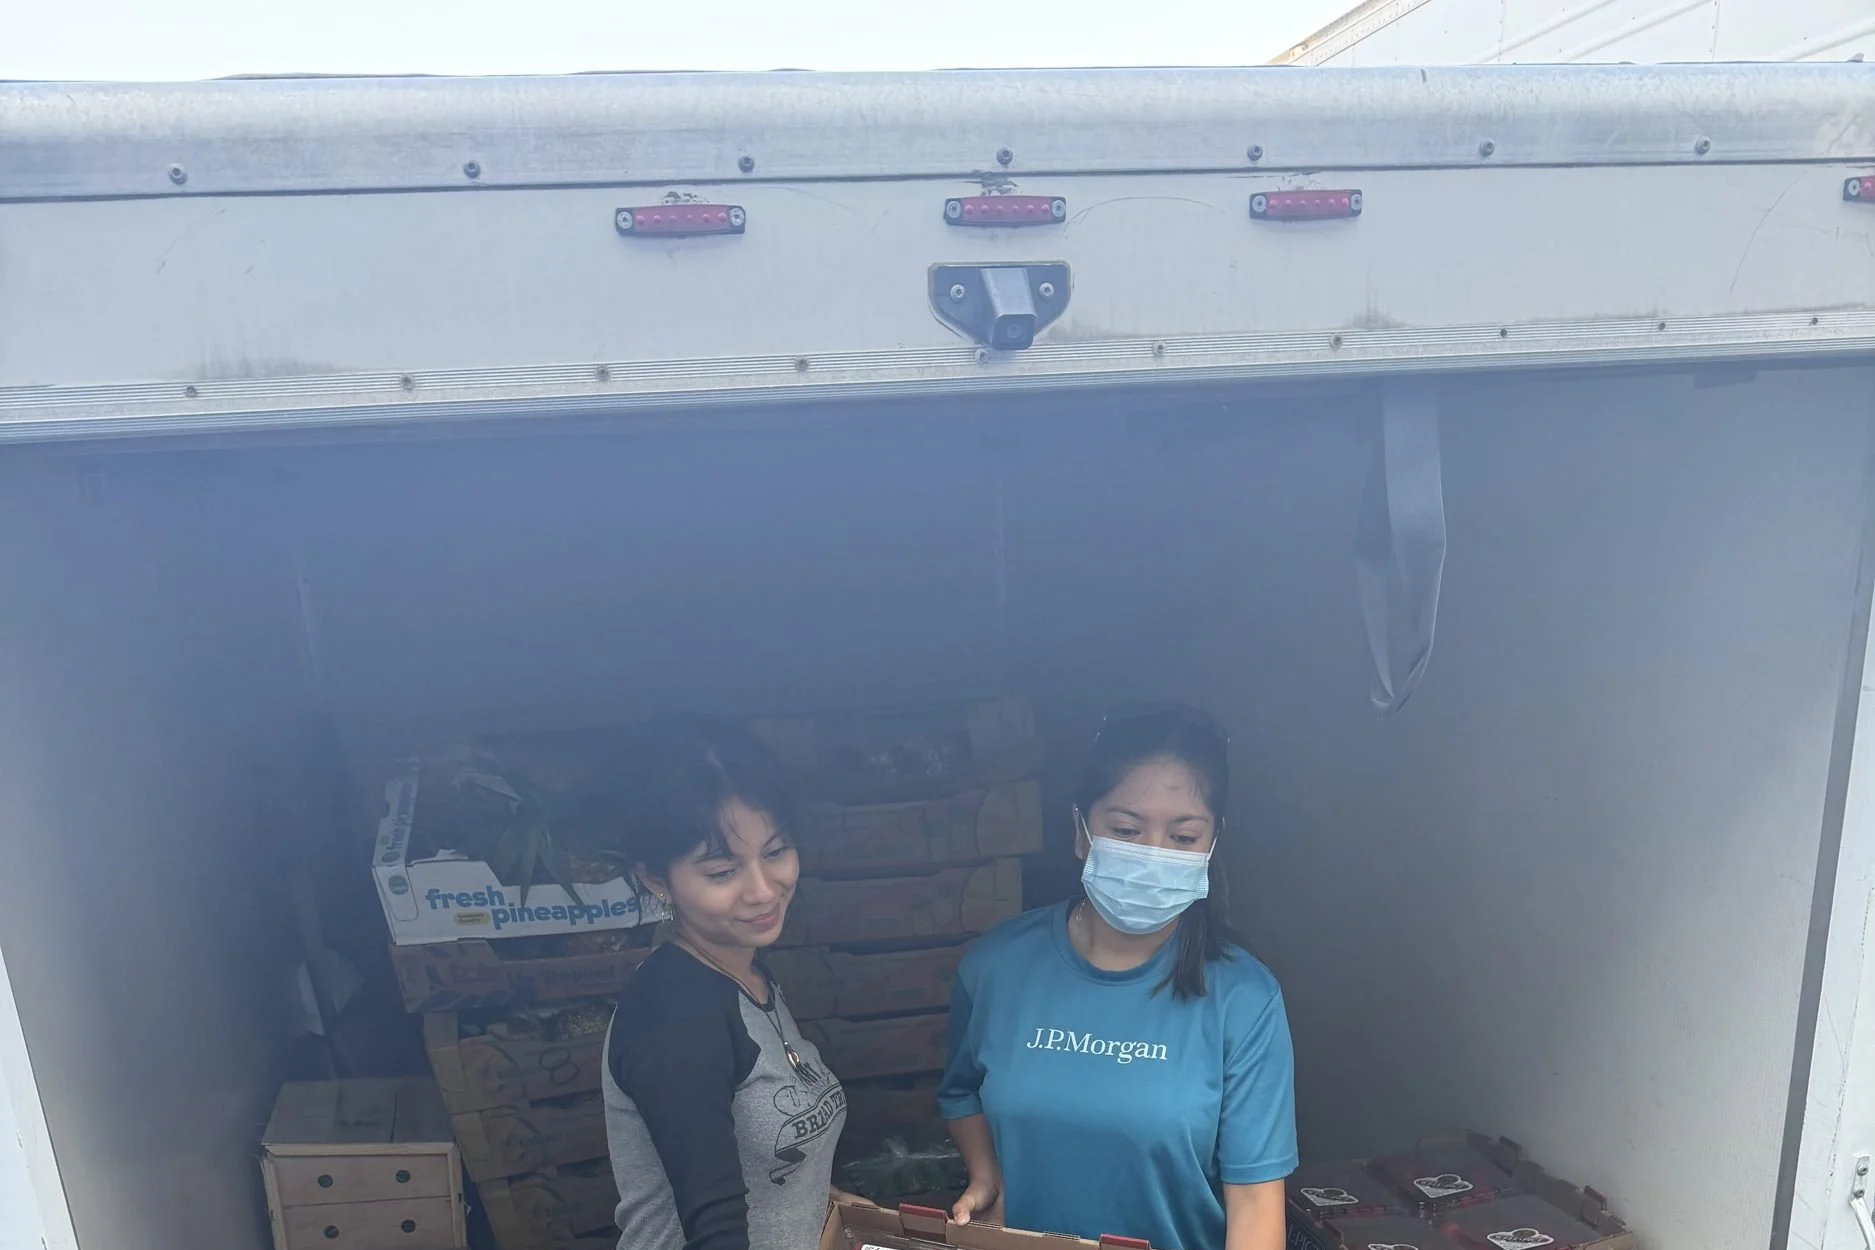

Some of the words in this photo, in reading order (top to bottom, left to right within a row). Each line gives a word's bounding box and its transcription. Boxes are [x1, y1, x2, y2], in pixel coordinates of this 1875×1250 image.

[425, 885, 505, 910] fresh
[491, 896, 639, 930] pineapples
[1026, 1027, 1168, 1064] J.P.Morgan
